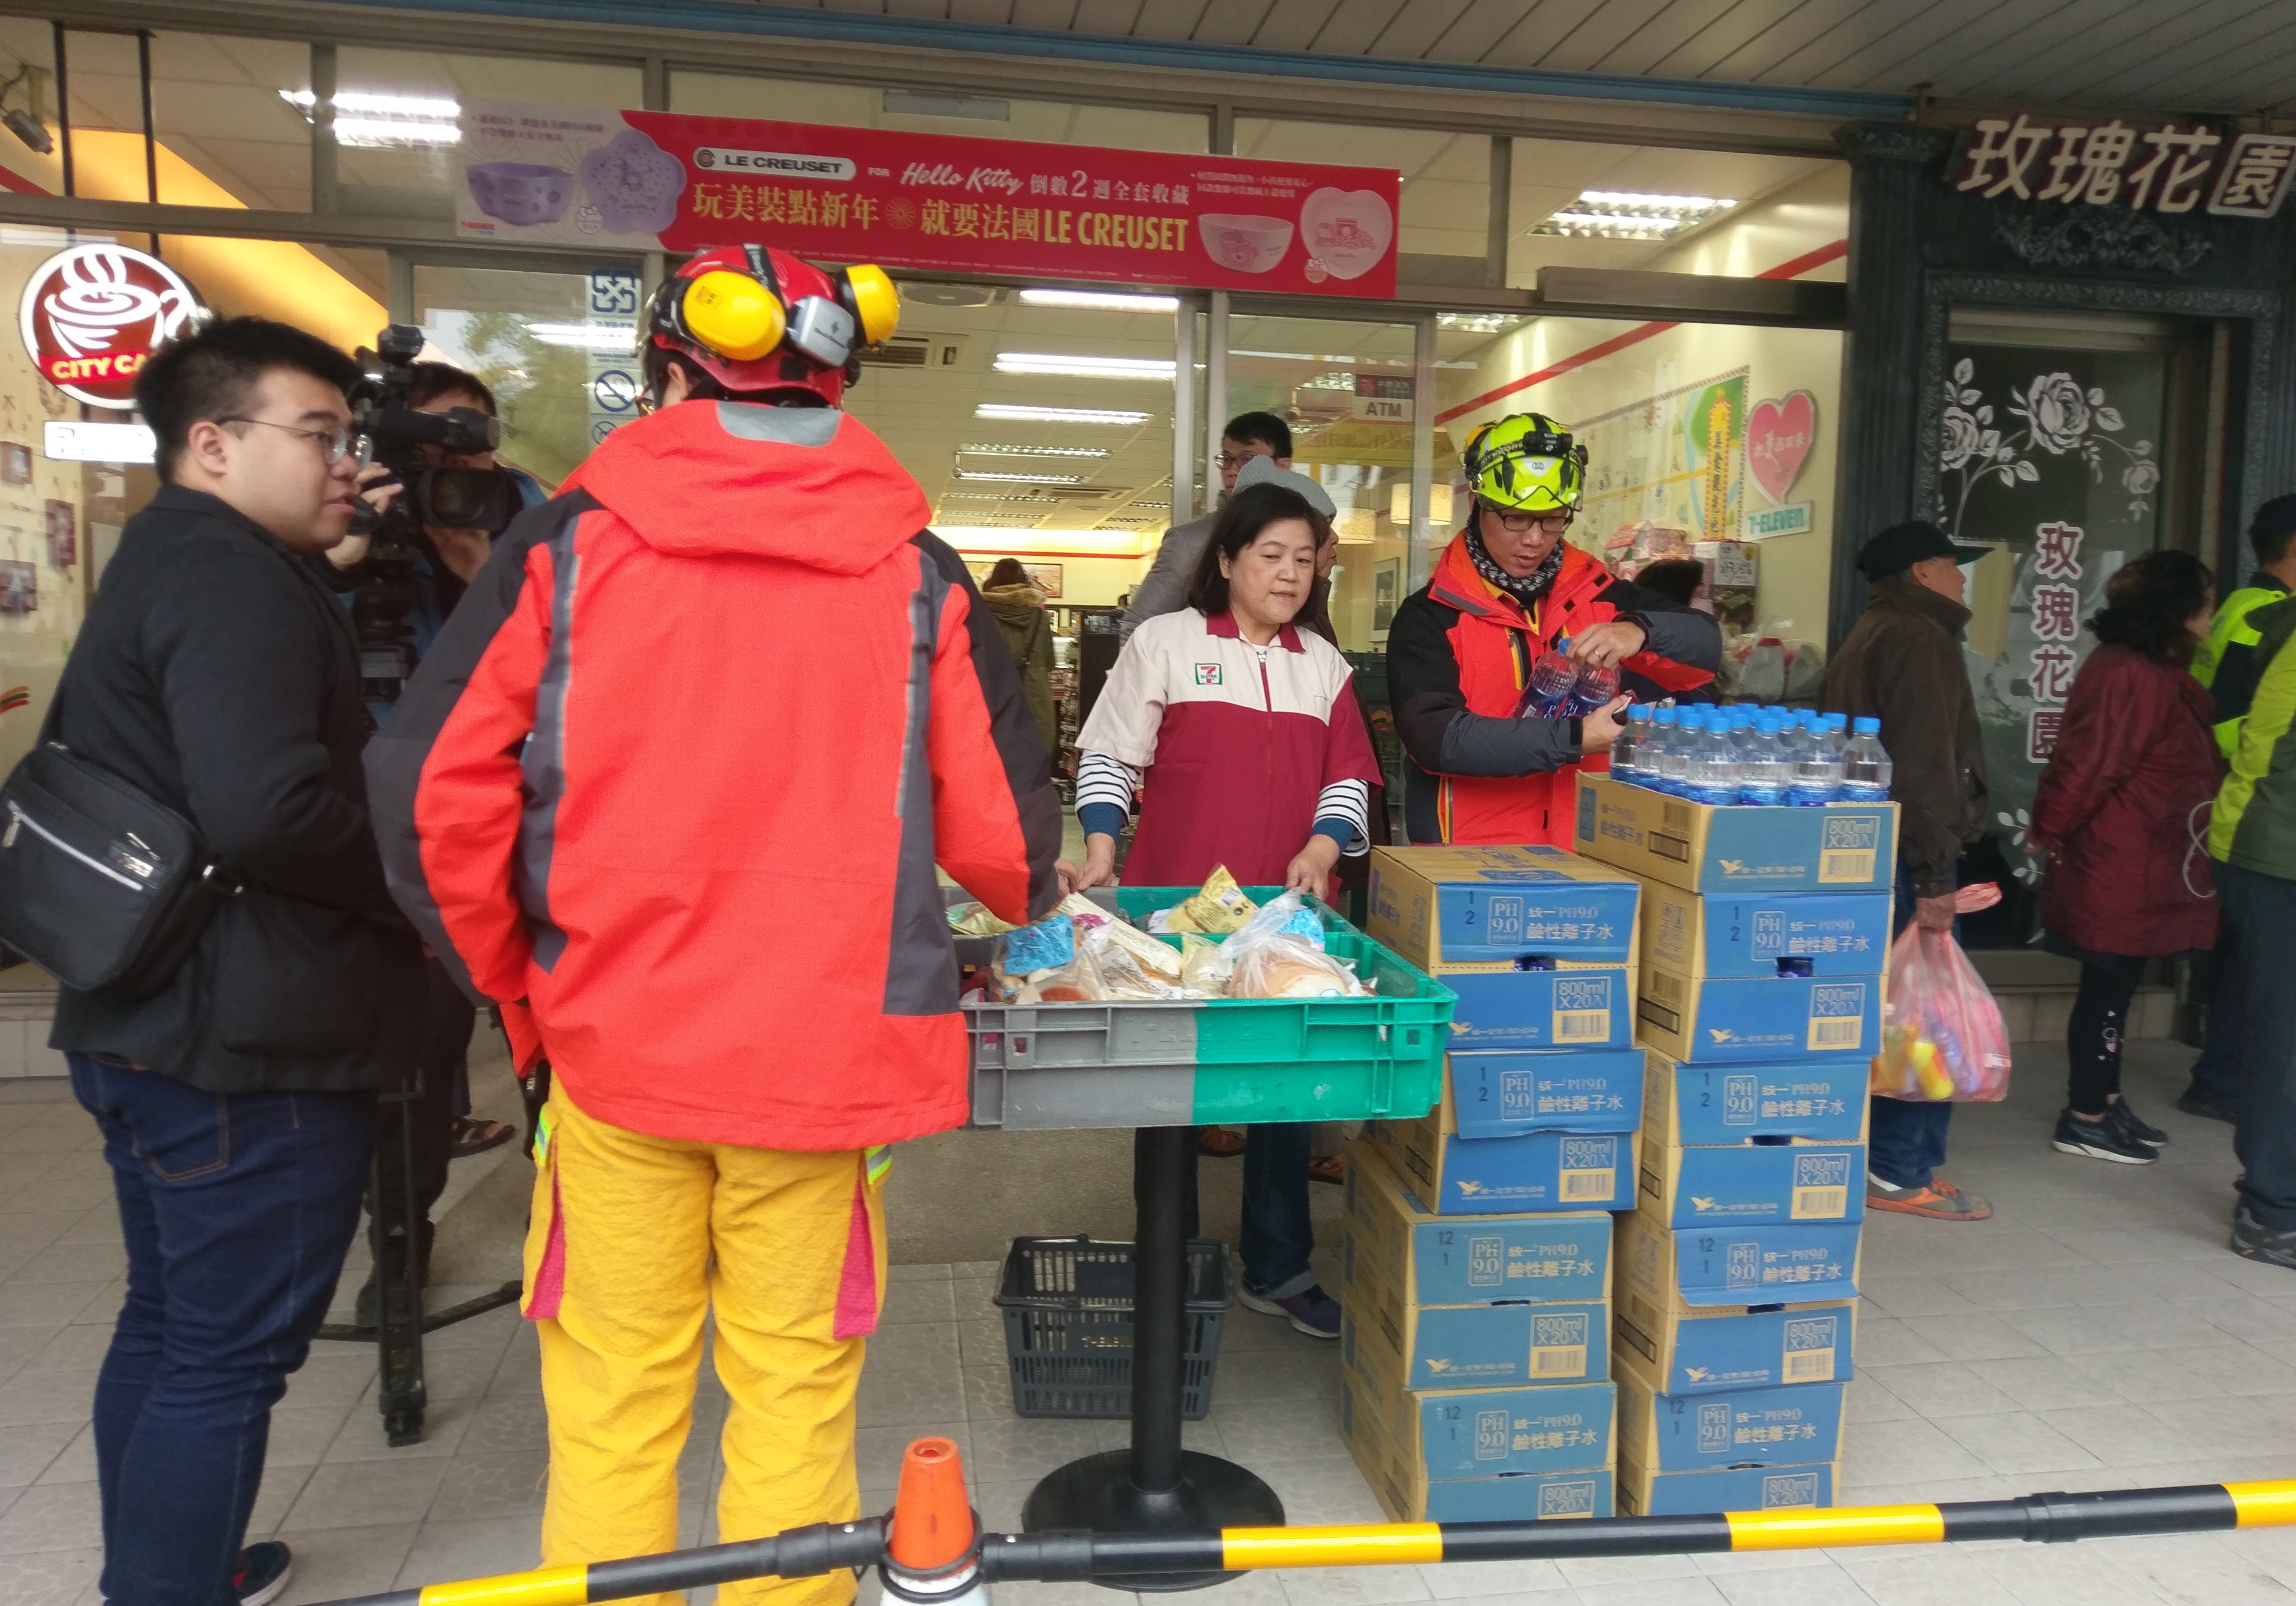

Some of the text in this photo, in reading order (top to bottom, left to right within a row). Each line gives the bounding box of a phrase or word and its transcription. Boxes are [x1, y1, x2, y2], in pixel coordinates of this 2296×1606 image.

[724, 155, 843, 173] LE CREUSET
[1957, 114, 2296, 218] 玫瑰花園
[900, 162, 1023, 195] Hello Kitty
[693, 182, 879, 230] 玩美裝點新年
[1044, 209, 1072, 243] LE
[1078, 212, 1189, 251] CREUSET
[52, 357, 111, 378] CITY
[1366, 402, 1402, 417] ATM
[1495, 903, 1517, 916] PH
[1492, 918, 1518, 933] 9.0
[1758, 918, 1780, 931] PH
[1756, 933, 1781, 948] 9.0
[1506, 1078, 1527, 1090] PH
[1730, 1082, 1752, 1096] PH
[1505, 1093, 1530, 1107] 9.0
[1728, 1097, 1753, 1113] 9.0
[1475, 1244, 1498, 1257] PH
[1733, 1250, 1754, 1263] PH
[1473, 1258, 1499, 1274] 9.0
[1731, 1264, 1755, 1280] 9.0
[1481, 1417, 1503, 1430] PH
[1703, 1410, 1726, 1424] PH
[1479, 1432, 1505, 1447] 9.0
[1702, 1425, 1727, 1440] 9.0
